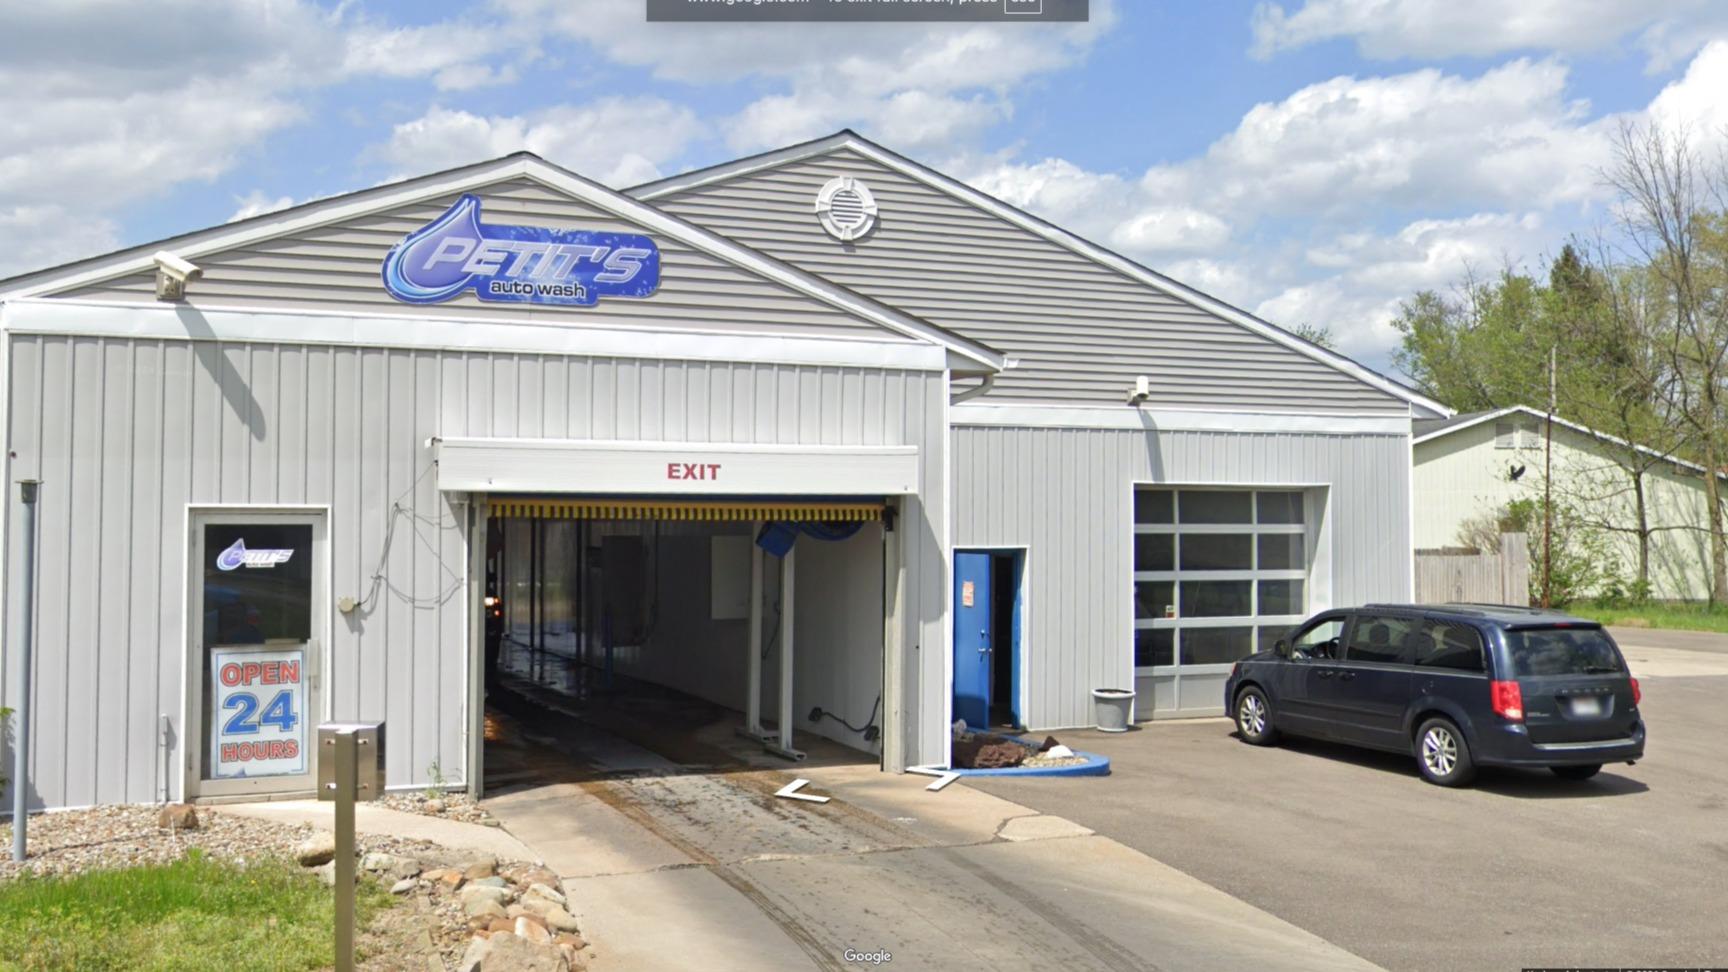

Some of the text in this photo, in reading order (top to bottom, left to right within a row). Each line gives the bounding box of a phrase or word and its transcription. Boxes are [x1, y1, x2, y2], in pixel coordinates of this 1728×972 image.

[422, 237, 650, 284] PETIT'S
[490, 281, 586, 298] auto wash
[667, 463, 721, 480] EXIT
[220, 660, 300, 687] OPEN
[222, 689, 298, 736] 24
[221, 739, 299, 763] HOURS
